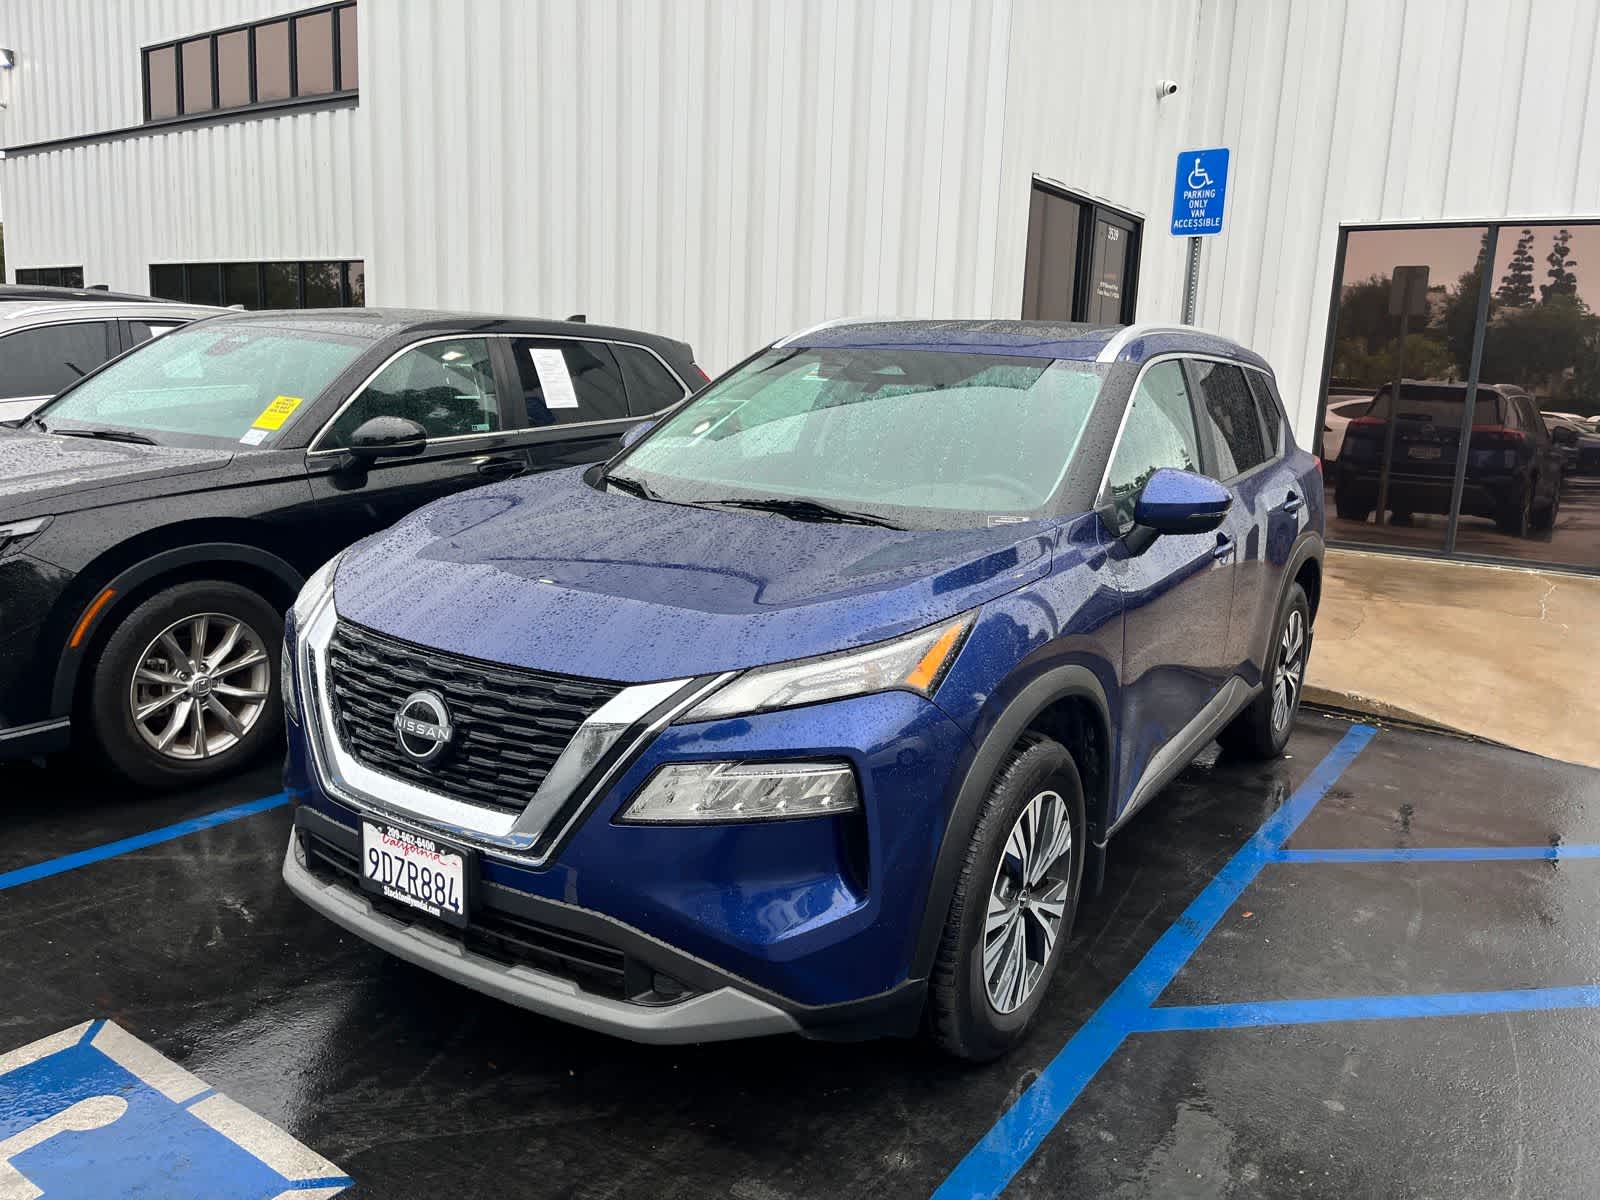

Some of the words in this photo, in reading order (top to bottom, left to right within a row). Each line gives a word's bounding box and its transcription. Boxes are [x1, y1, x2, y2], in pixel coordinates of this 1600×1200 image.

[1183, 189, 1216, 199] PARKING
[1188, 199, 1208, 209] ONLY
[1191, 209, 1206, 218] VAN
[1173, 217, 1221, 229] ACCESSIBLE
[396, 716, 449, 740] NISSAN
[368, 847, 460, 912] 9DZR884
